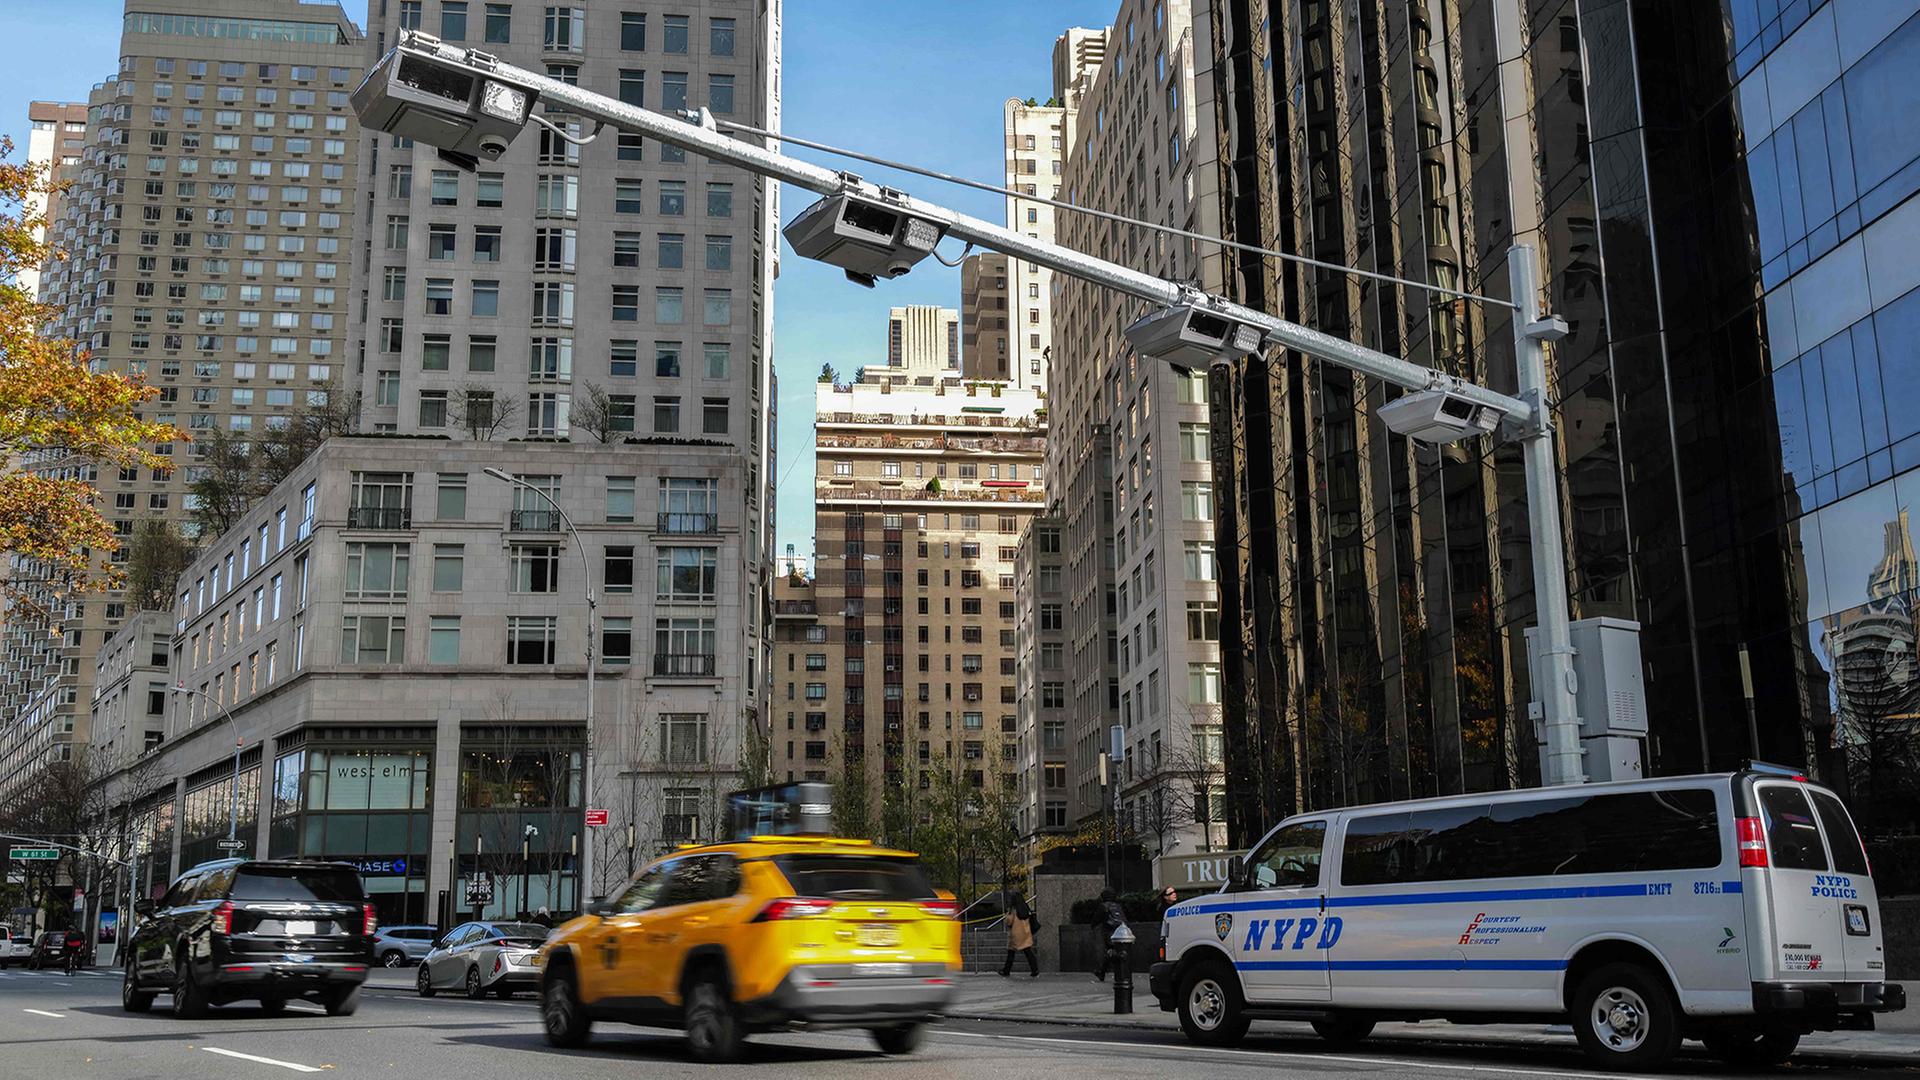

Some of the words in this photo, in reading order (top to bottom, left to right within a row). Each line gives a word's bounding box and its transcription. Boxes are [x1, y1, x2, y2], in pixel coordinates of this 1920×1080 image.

[338, 767, 375, 778] west
[382, 765, 411, 778] elm
[350, 861, 390, 872] HASE
[1183, 859, 1230, 883] TRU
[1815, 875, 1851, 887] NYPD
[466, 885, 492, 894] PARK
[1648, 883, 1673, 895] EMFT
[1811, 886, 1857, 899] POLICE
[1176, 904, 1200, 917] POLICE
[1243, 916, 1343, 951] NYPD
